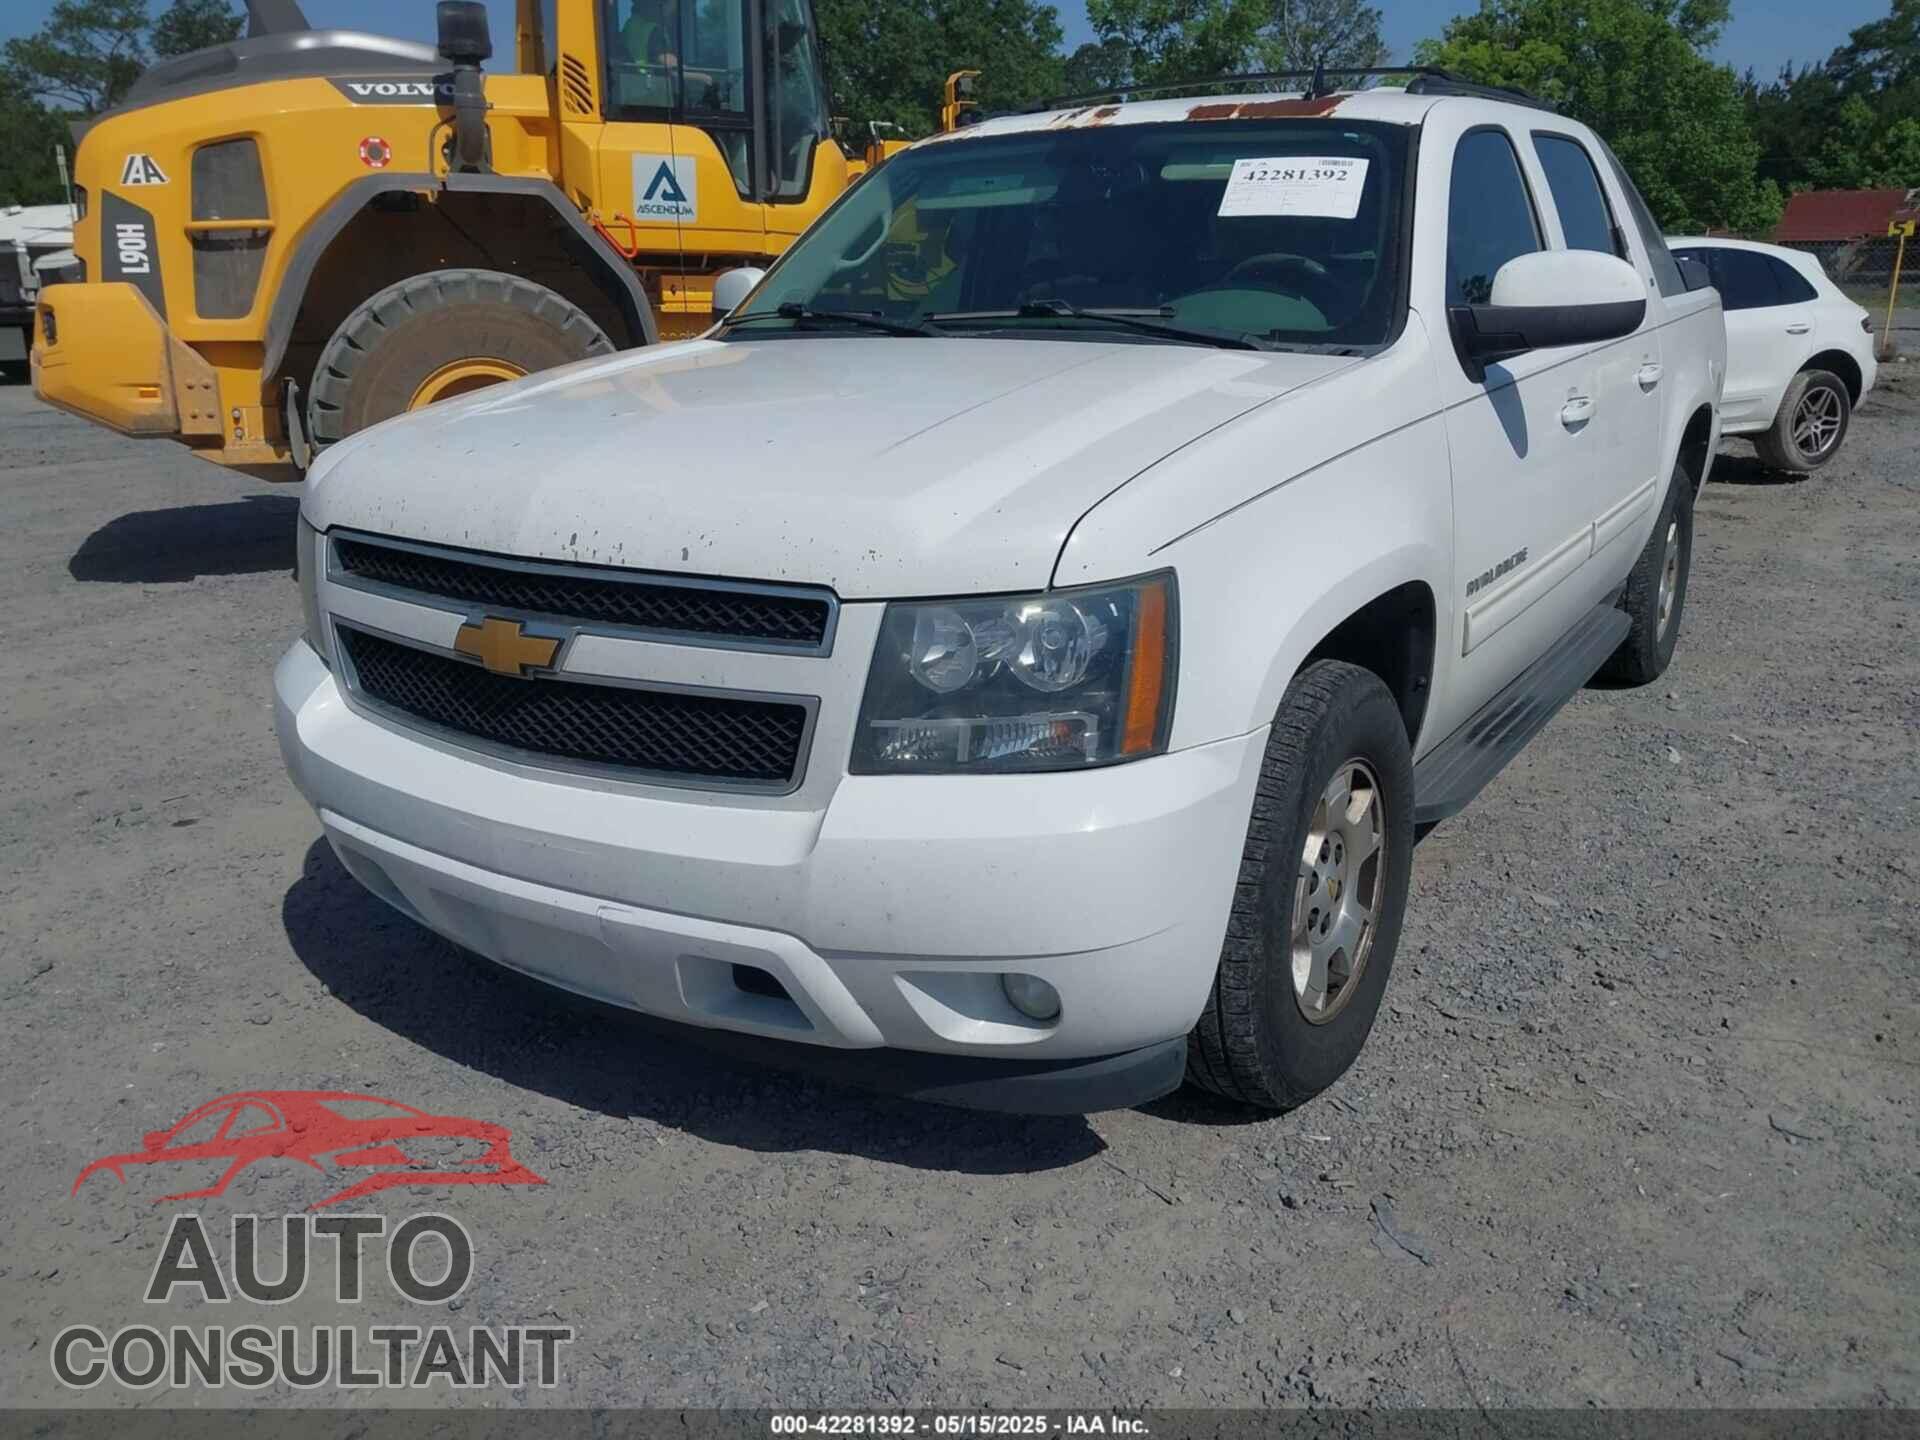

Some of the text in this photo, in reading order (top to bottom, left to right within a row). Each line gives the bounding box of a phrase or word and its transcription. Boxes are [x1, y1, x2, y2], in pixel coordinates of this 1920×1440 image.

[1243, 169, 1349, 181] 42281392
[637, 204, 695, 216] ASCENDUM
[115, 223, 150, 273] L90H
